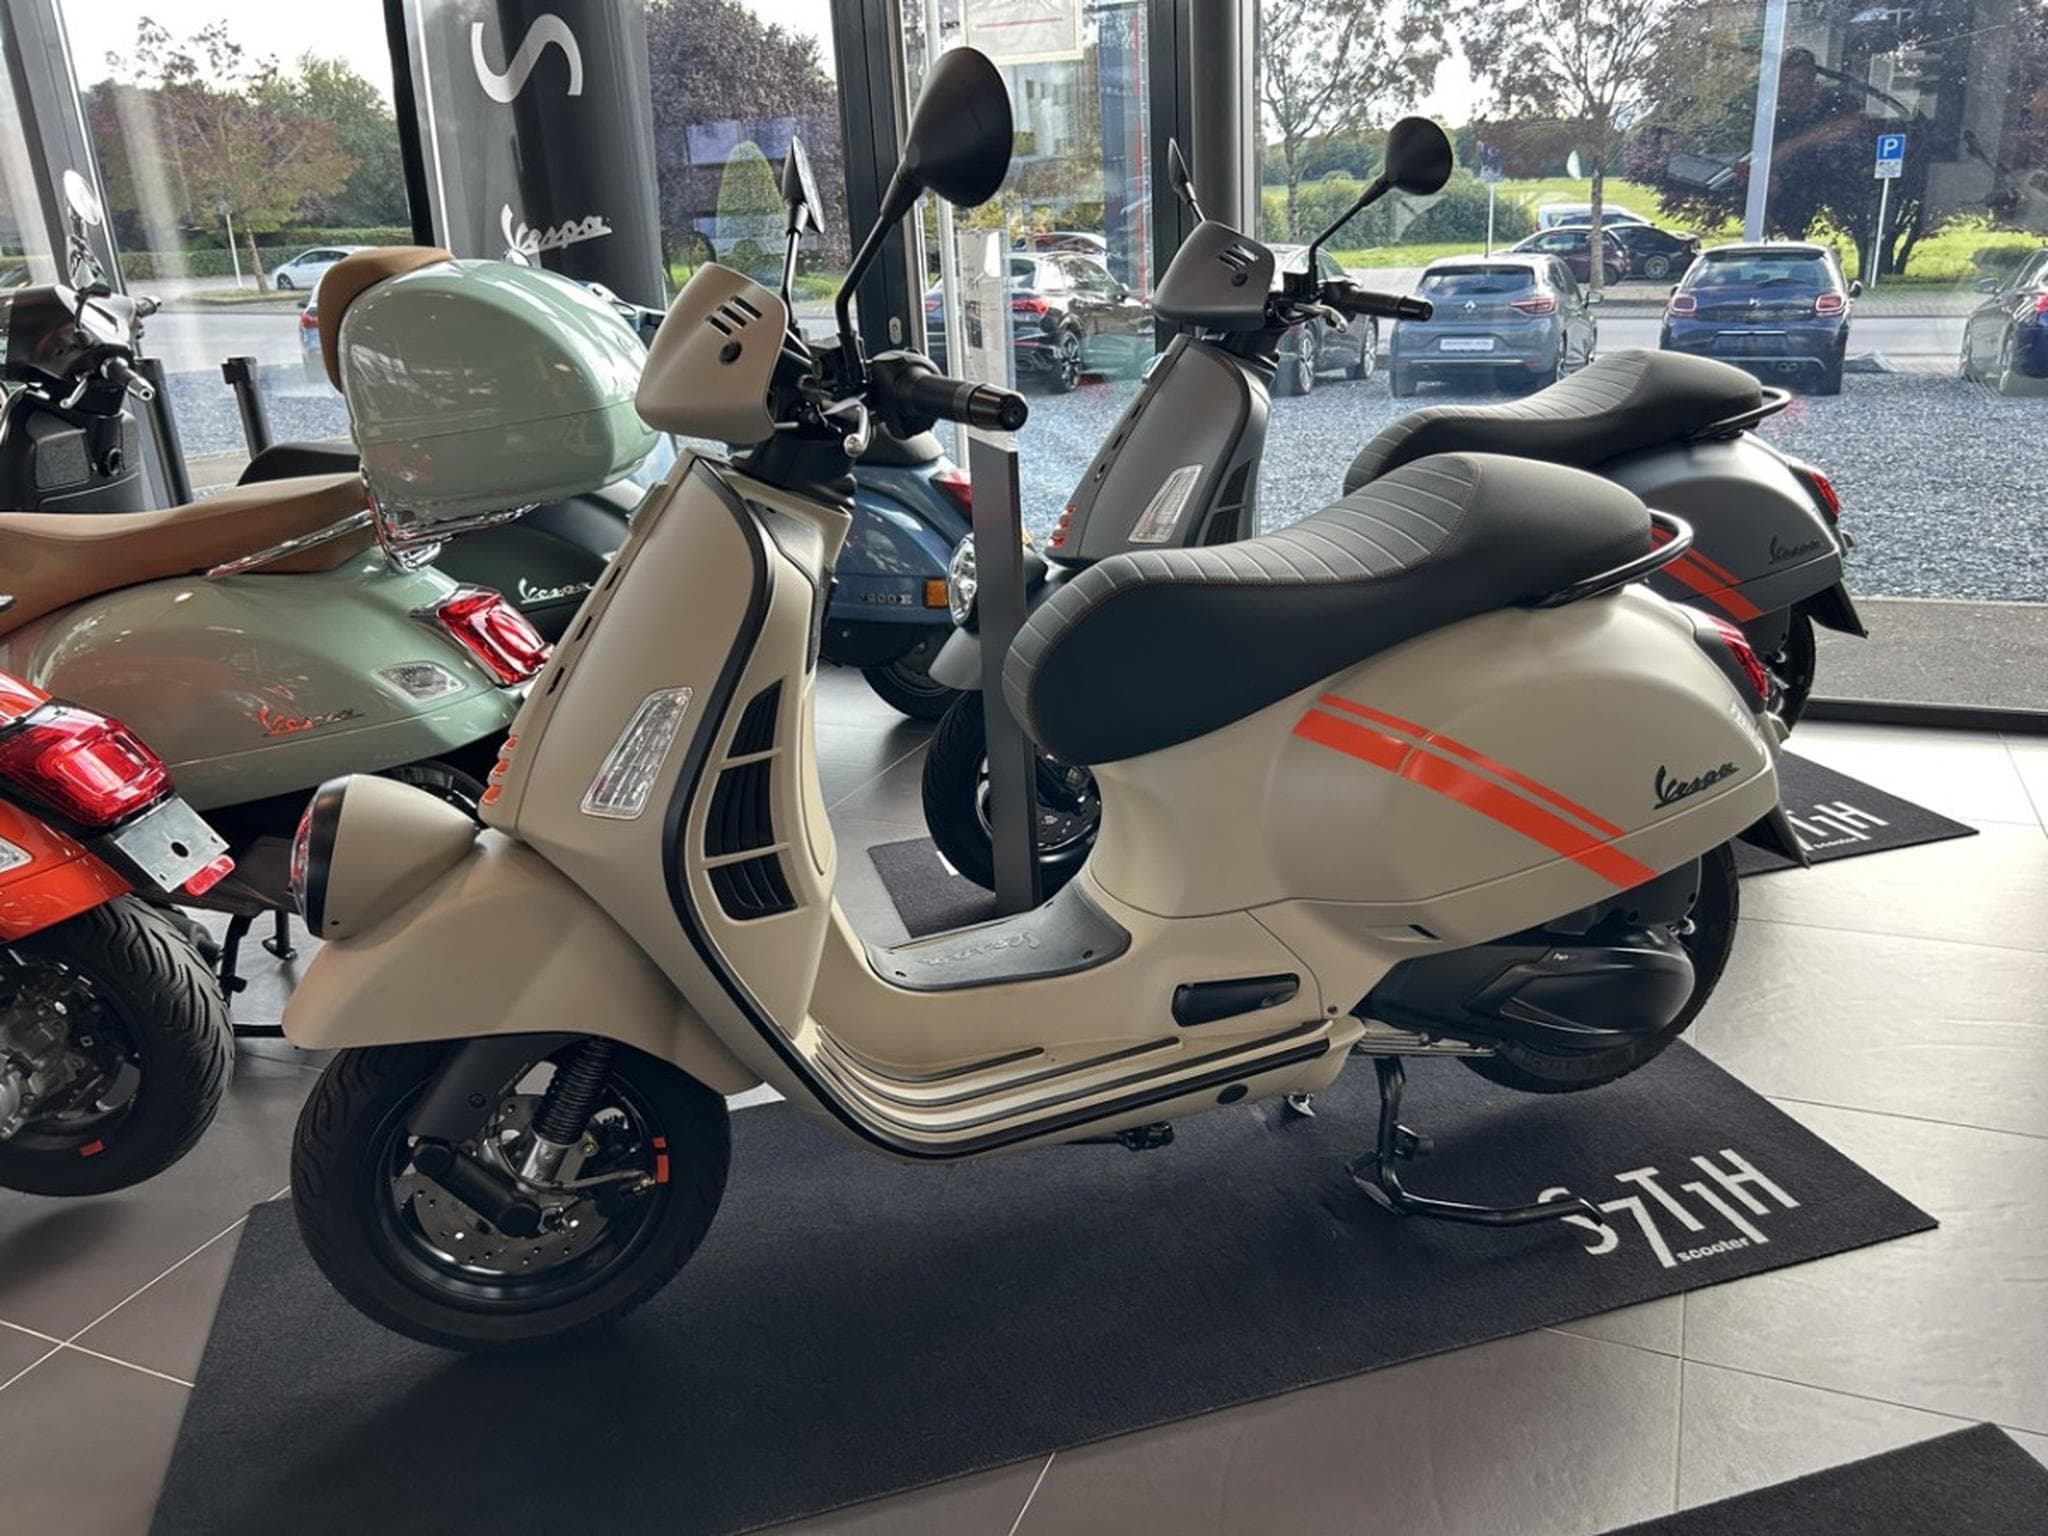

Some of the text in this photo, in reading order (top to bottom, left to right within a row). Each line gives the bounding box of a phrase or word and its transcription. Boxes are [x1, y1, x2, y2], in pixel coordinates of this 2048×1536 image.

[1883, 138, 1898, 157] P
[501, 204, 612, 258] Vespa
[1653, 762, 1740, 810] Vespa
[1676, 1237, 1750, 1262] scooter
